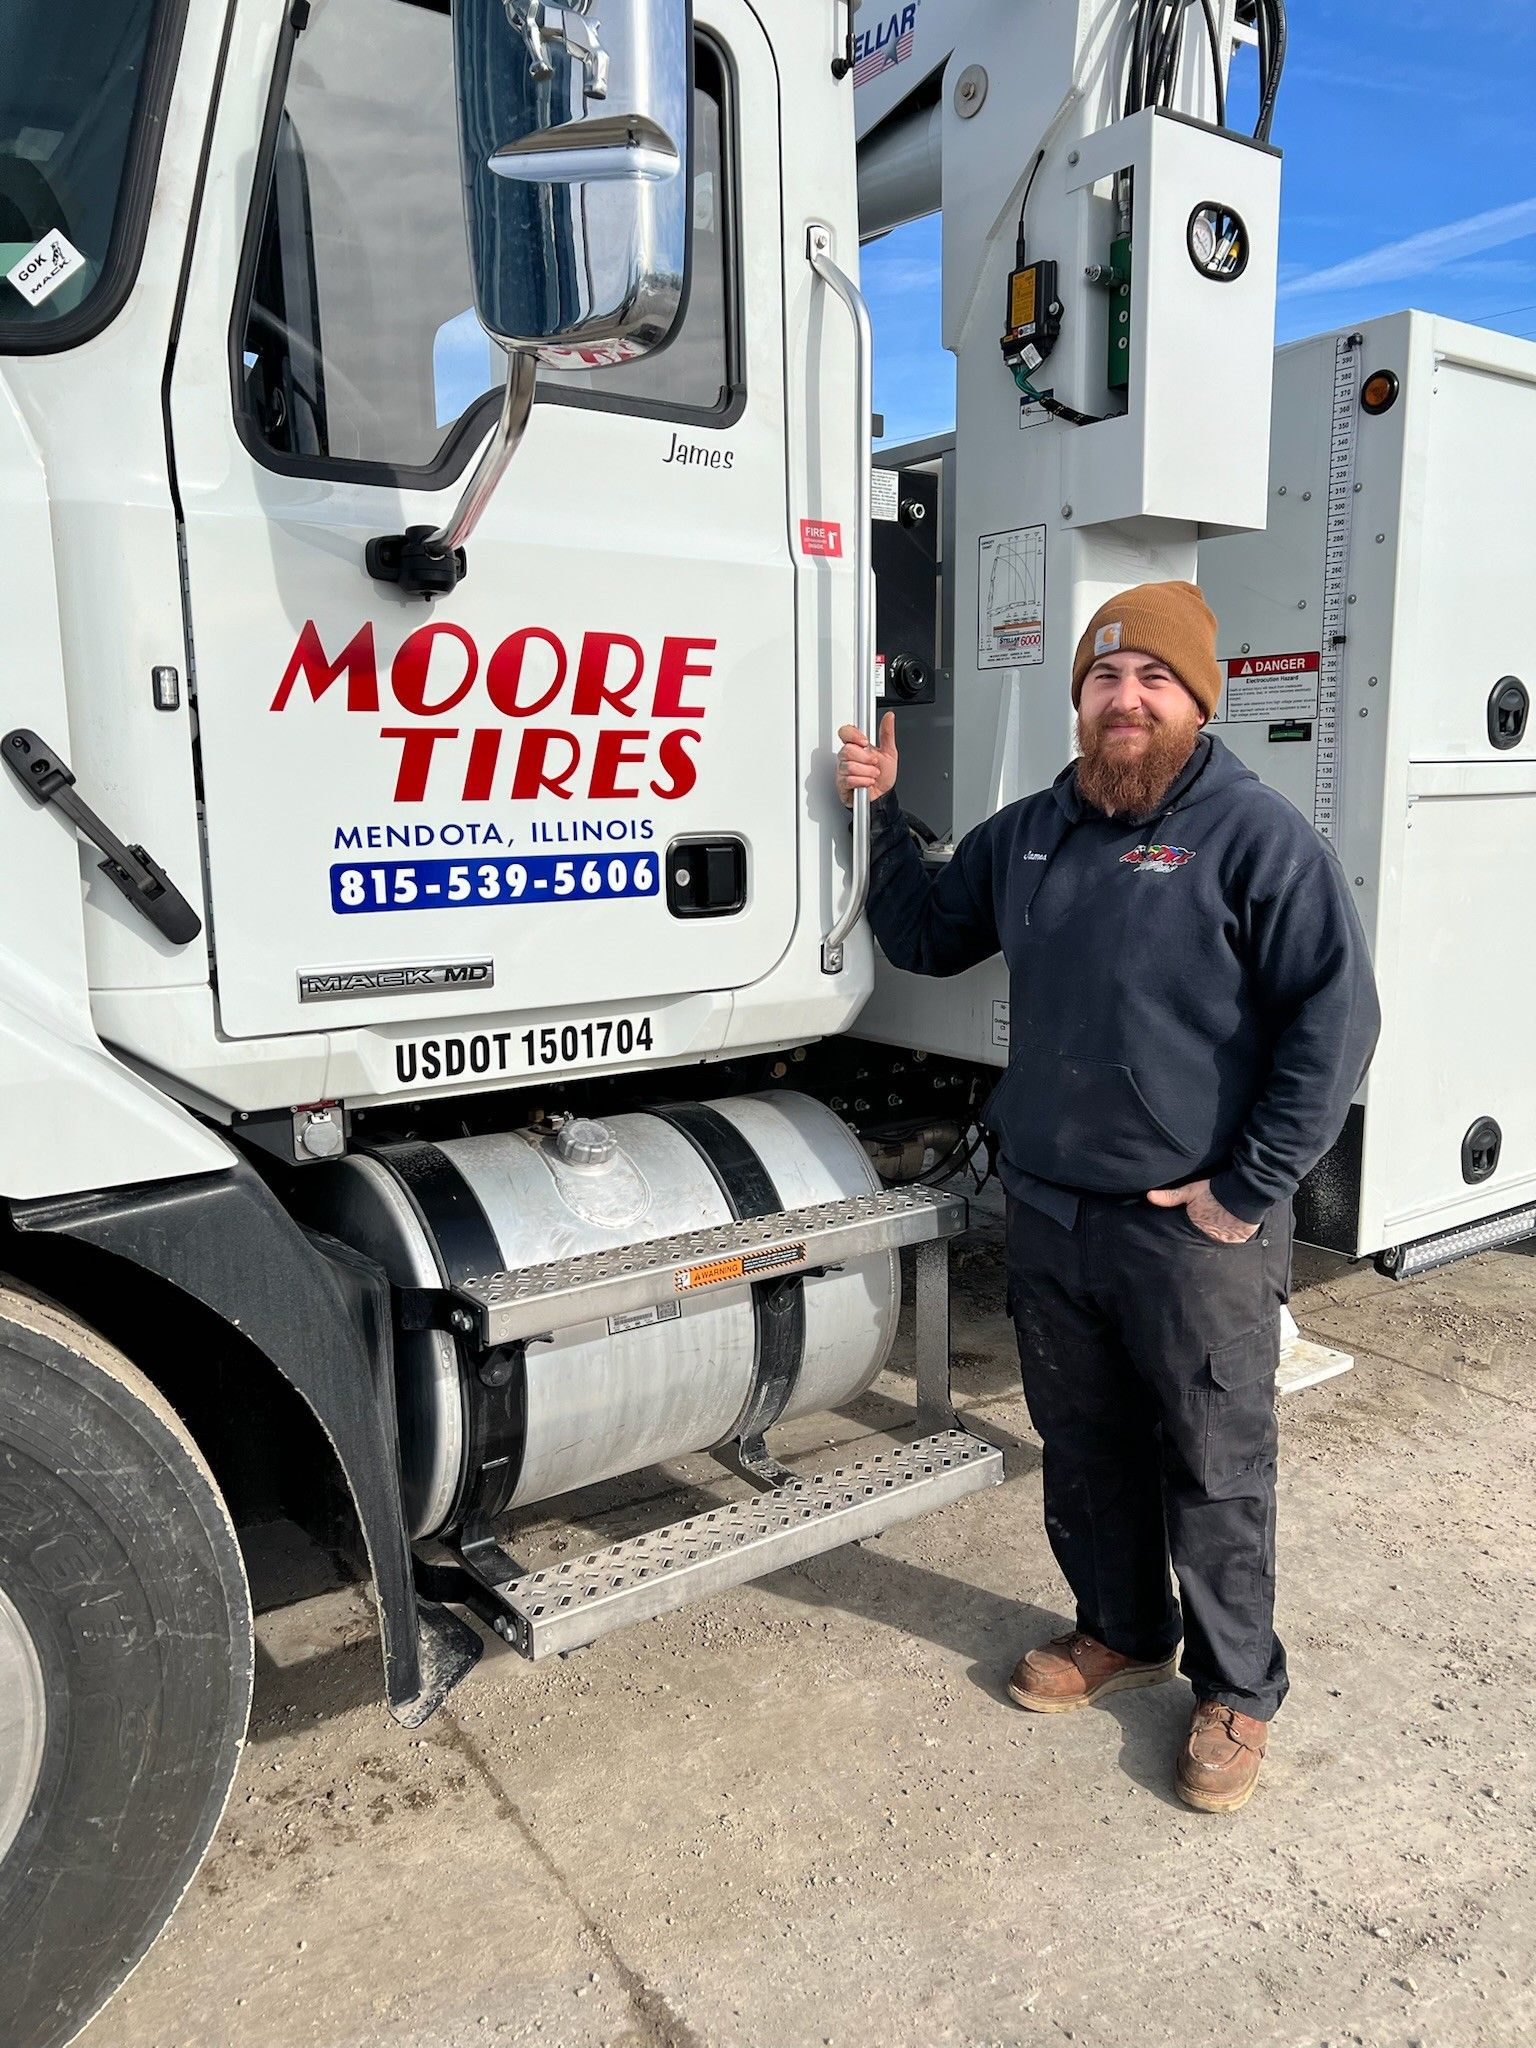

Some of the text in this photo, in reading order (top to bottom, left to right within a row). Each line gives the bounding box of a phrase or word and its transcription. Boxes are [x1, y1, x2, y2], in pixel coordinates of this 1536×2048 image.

[18, 253, 47, 281] GOK
[31, 259, 71, 294] MACK
[662, 433, 734, 469] James
[805, 527, 826, 538] FIRE
[1020, 634, 1041, 646] 6000
[269, 619, 717, 718] MOORE
[1255, 658, 1305, 672] DANGER
[379, 727, 702, 803] TIRES
[334, 819, 654, 849] MENDOTA, ILLINOIS
[1023, 850, 1048, 861] James
[339, 858, 654, 906] 815-539-5606
[307, 965, 488, 993] MACK MD
[395, 1017, 653, 1083] USDOT 1501704
[701, 1264, 738, 1279] WARNING
